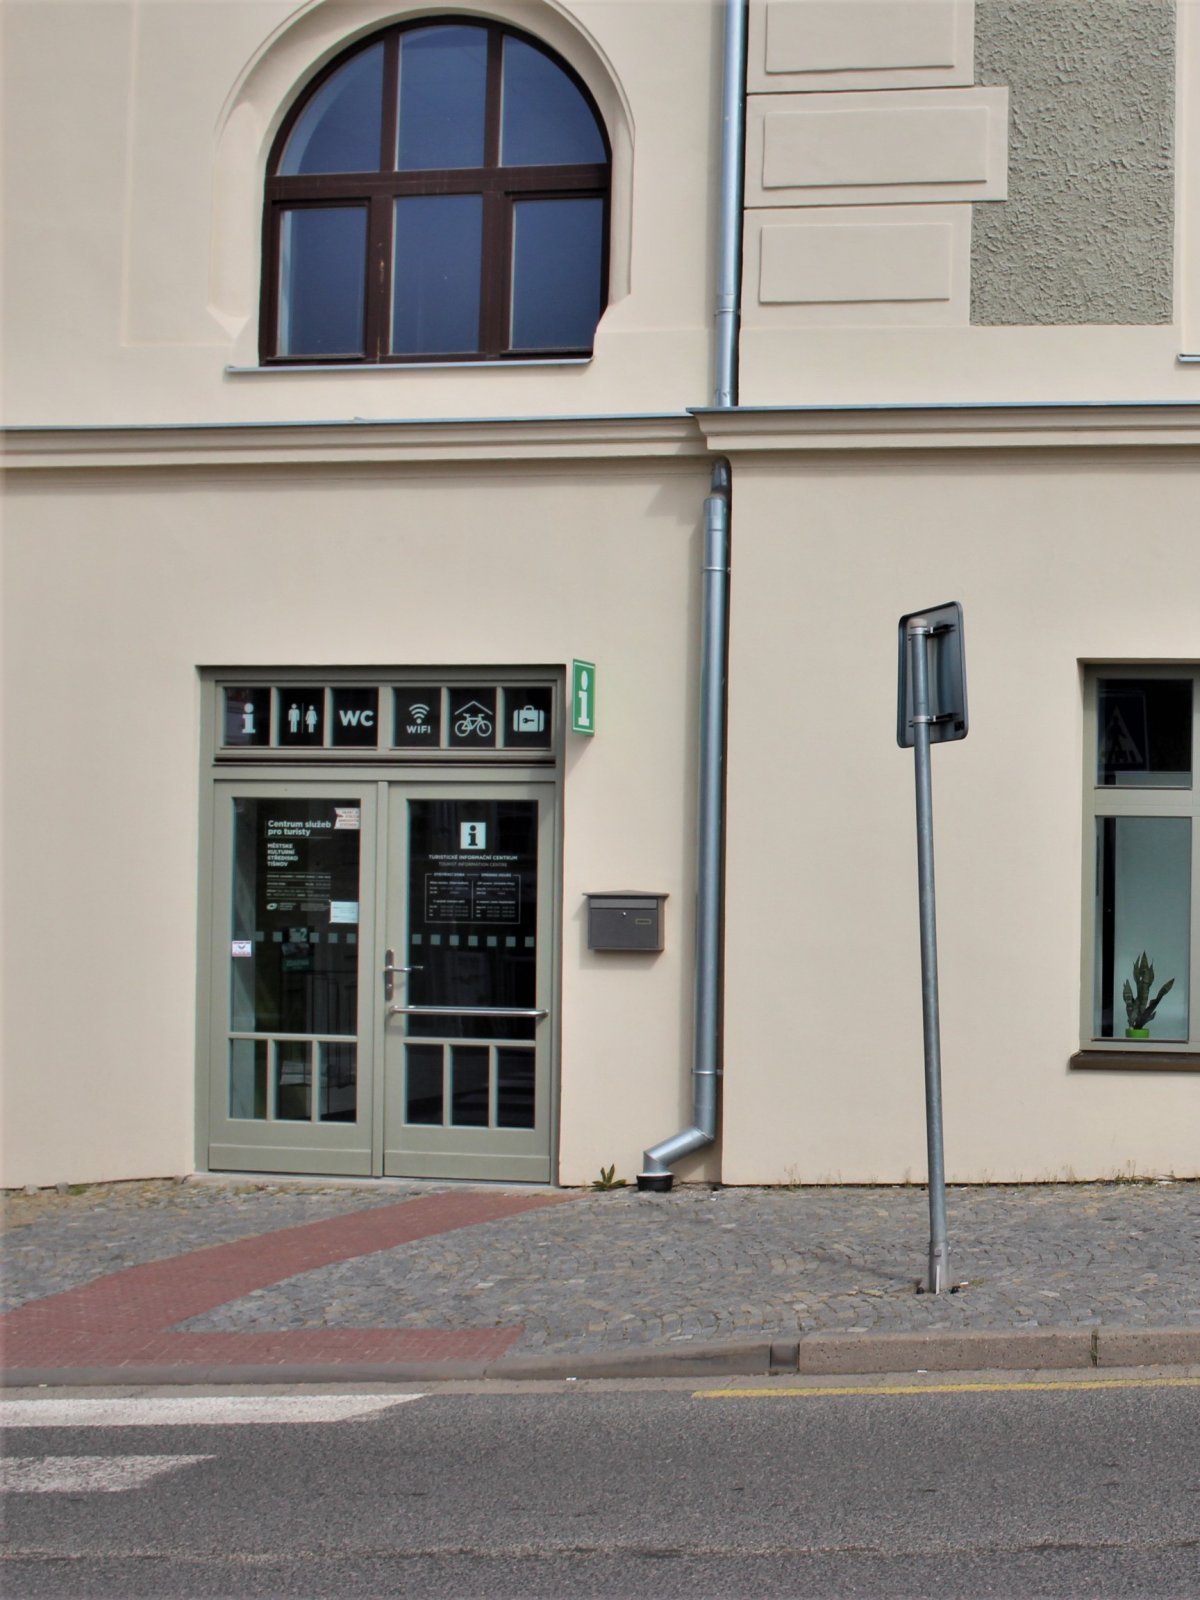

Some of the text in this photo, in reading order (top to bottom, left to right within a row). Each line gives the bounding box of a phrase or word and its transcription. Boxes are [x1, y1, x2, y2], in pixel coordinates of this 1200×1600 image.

[339, 709, 374, 727] WC
[406, 725, 431, 734] WIFI
[267, 820, 332, 828] Centrum služeb
[267, 828, 311, 837] pro turisty
